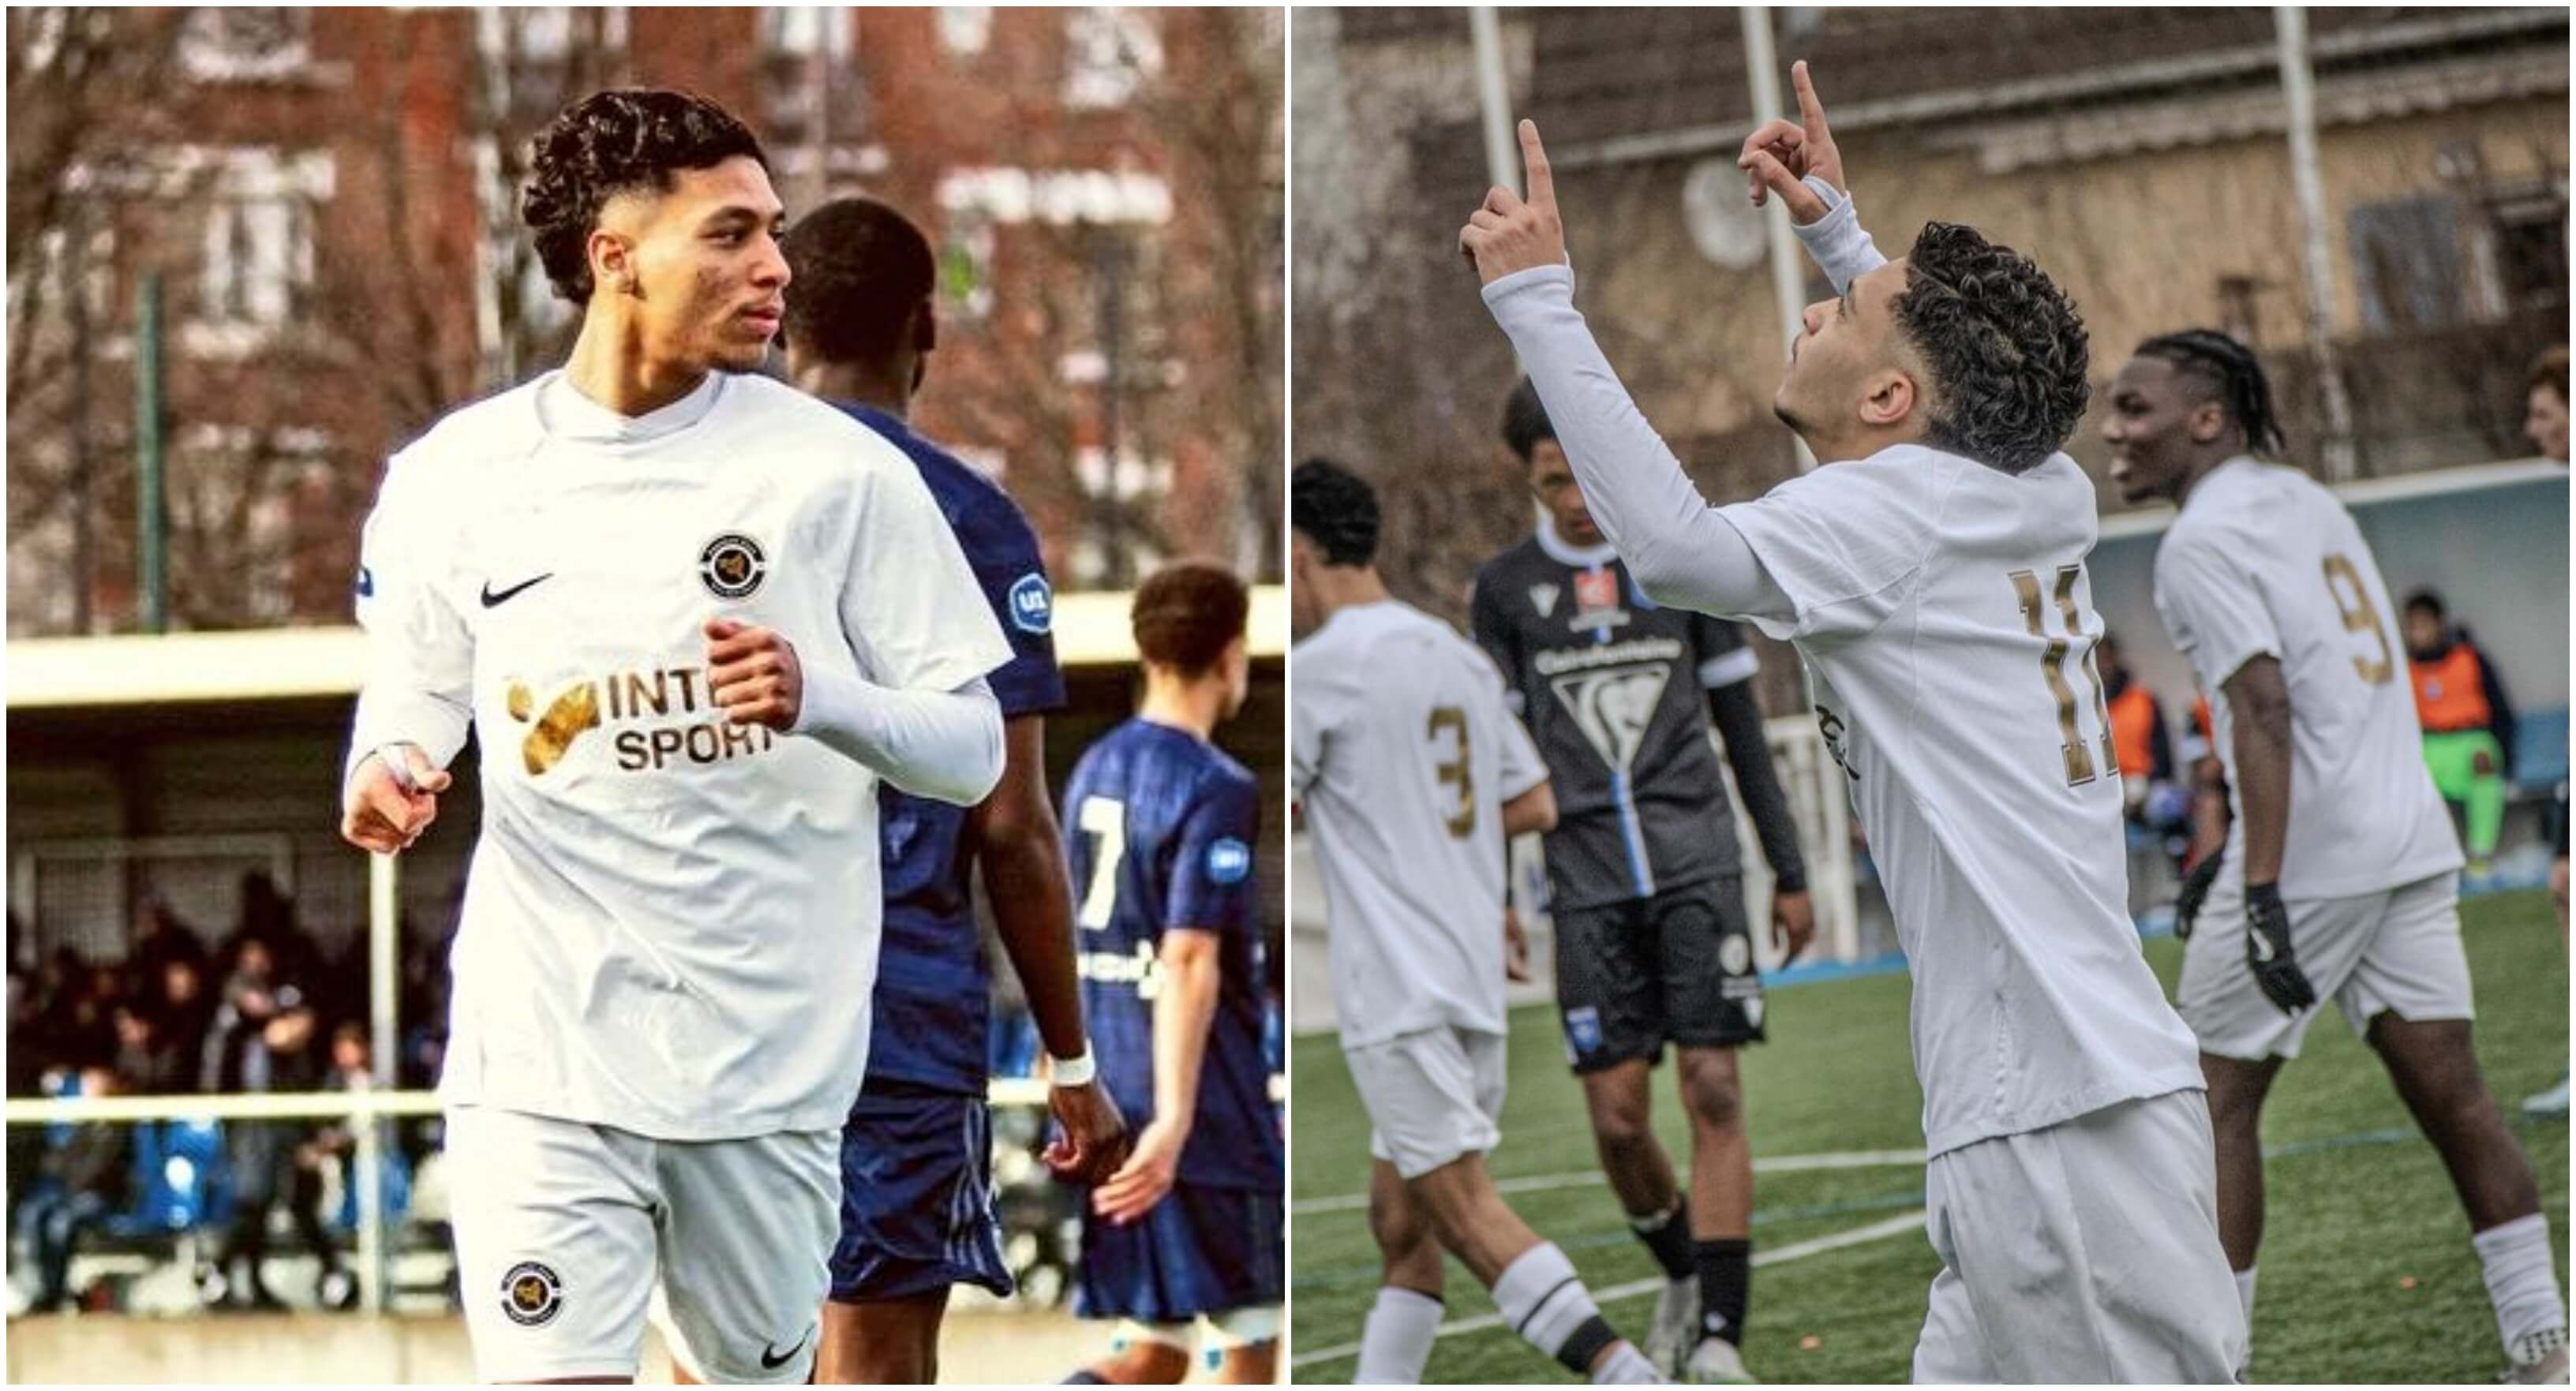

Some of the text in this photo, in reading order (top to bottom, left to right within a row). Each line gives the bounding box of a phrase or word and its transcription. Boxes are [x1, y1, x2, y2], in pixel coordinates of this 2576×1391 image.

[2007, 563, 2120, 787] 11
[2322, 553, 2394, 685] 9
[609, 667, 728, 720] INT
[1428, 705, 1475, 840] 3
[1079, 795, 1125, 930] 7
